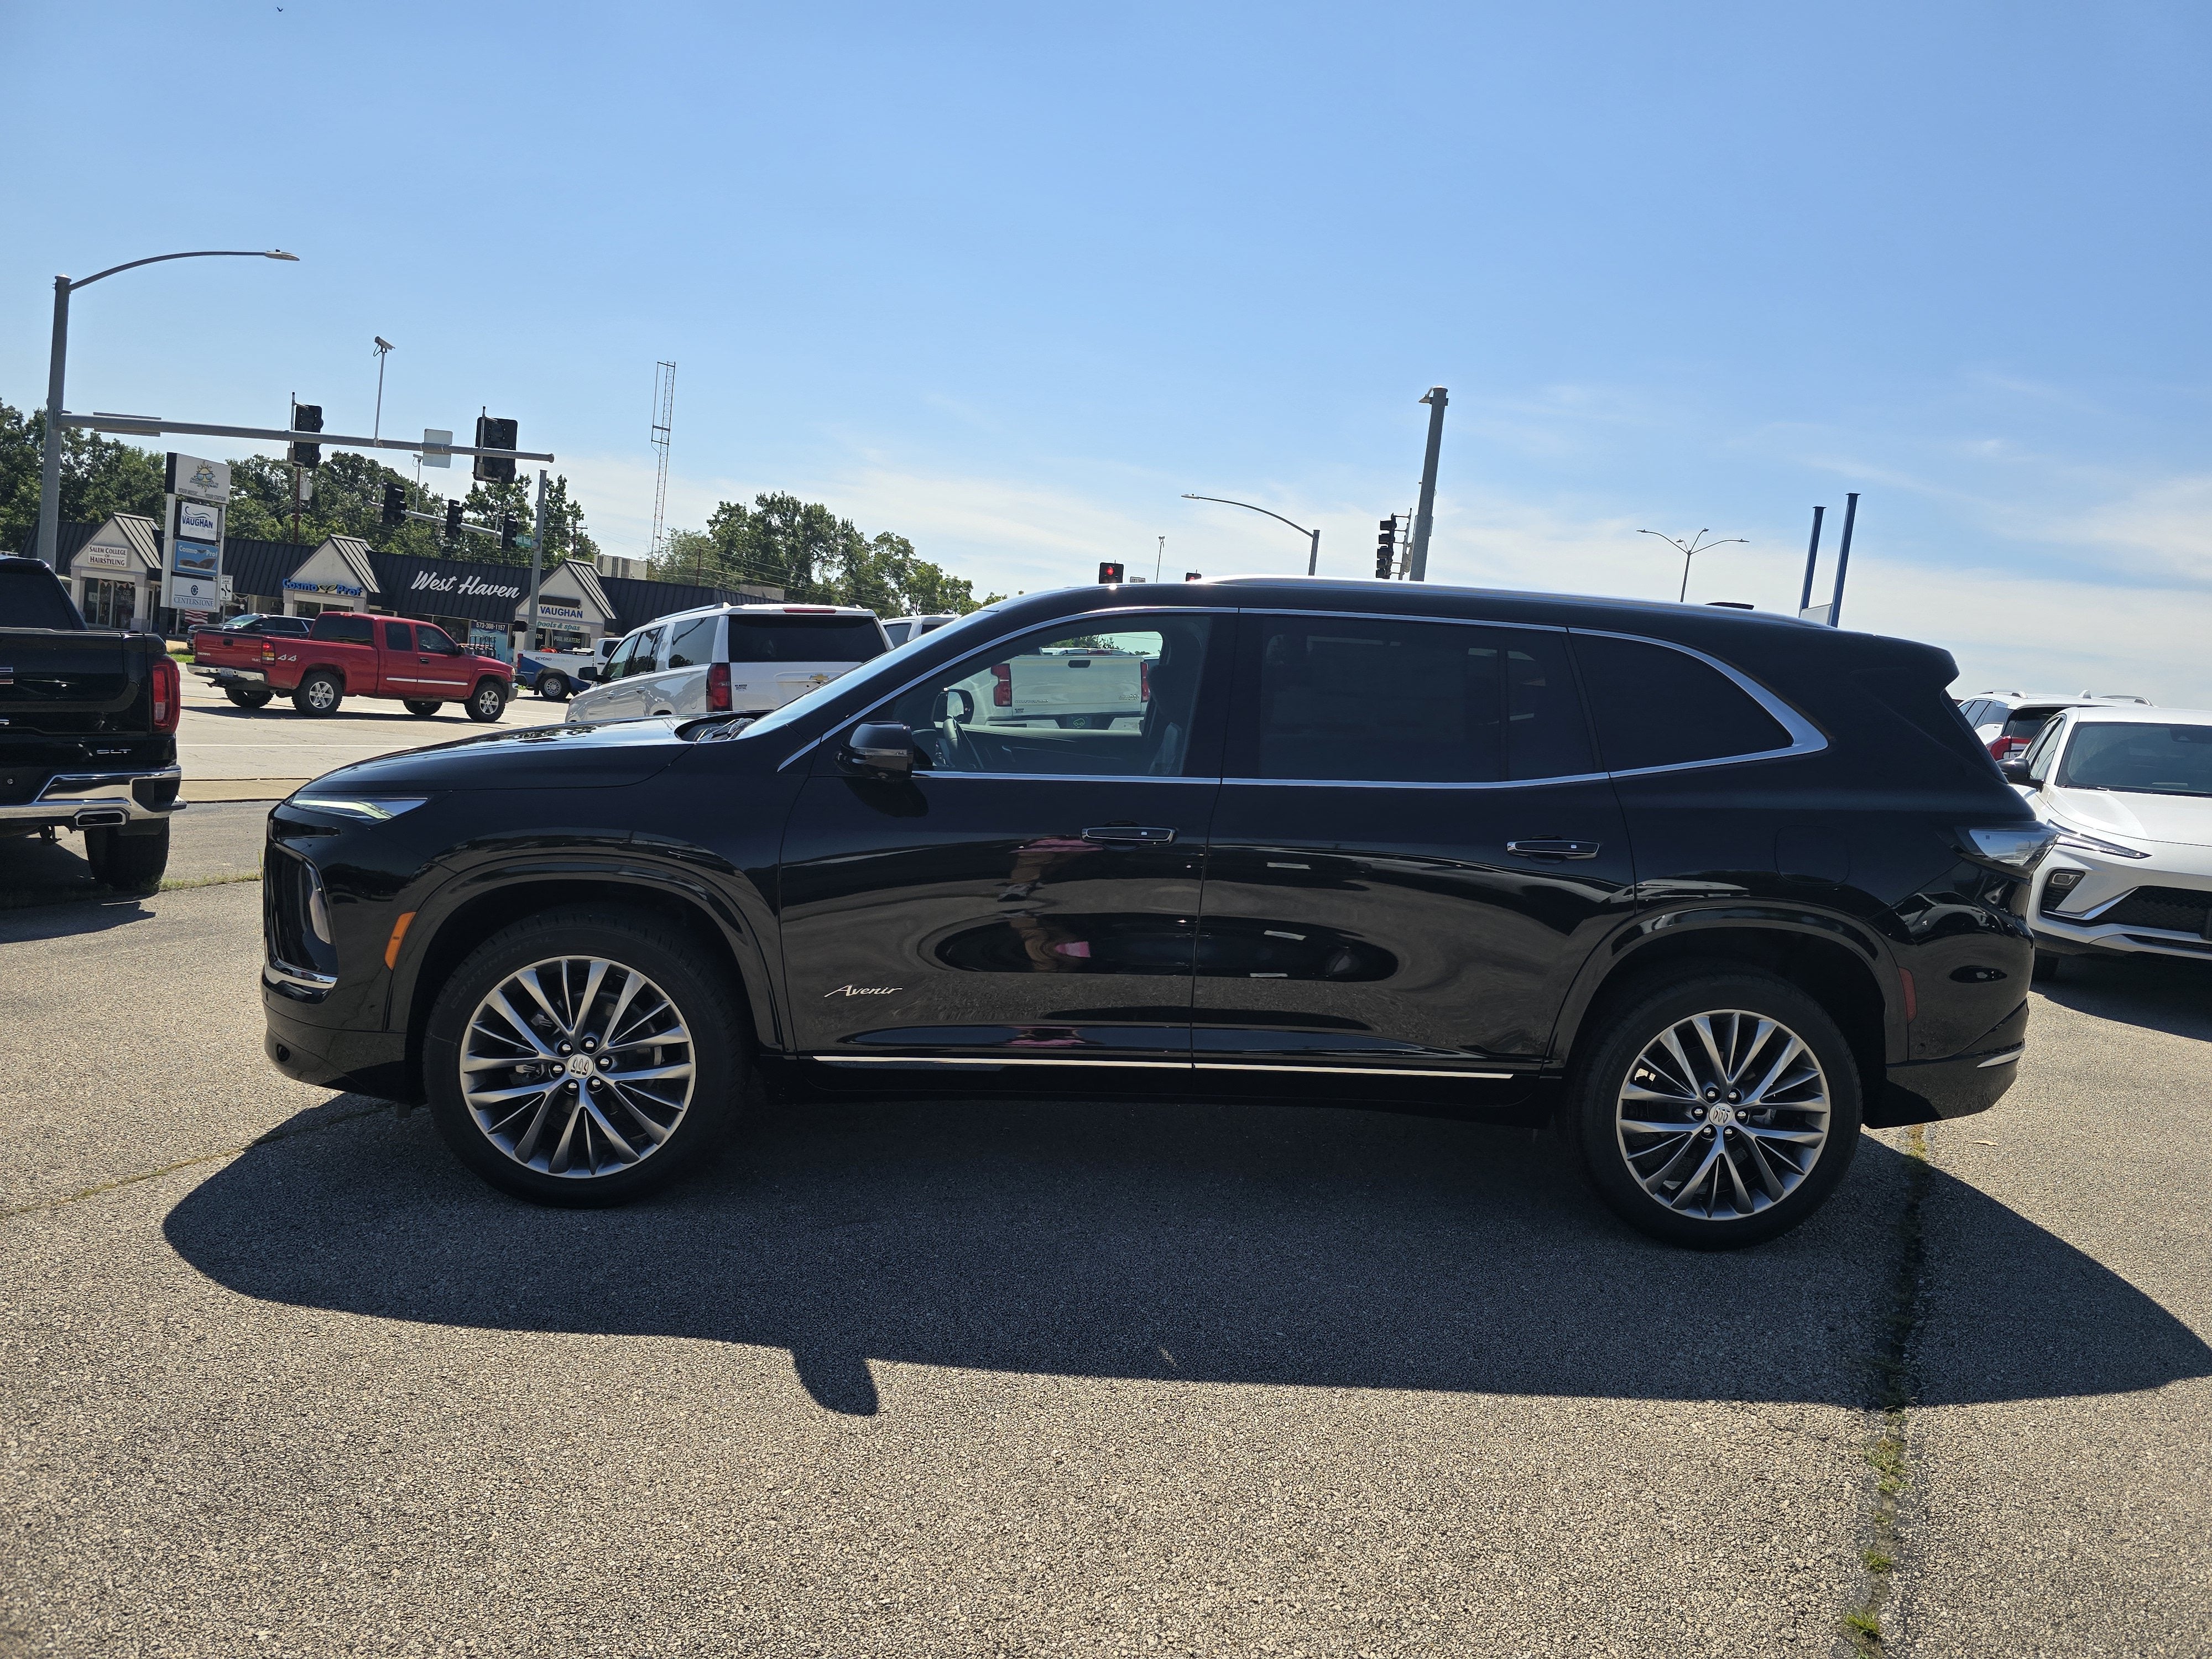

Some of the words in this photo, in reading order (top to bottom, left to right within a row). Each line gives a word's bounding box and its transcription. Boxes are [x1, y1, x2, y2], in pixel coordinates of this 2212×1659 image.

[182, 515, 213, 529] VAUGHAN
[179, 545, 197, 554] Cosmo
[90, 556, 125, 566] HAIRSTYLING
[283, 578, 319, 592] Cosmo
[336, 584, 363, 597] Prof
[411, 570, 457, 592] West
[457, 575, 520, 599] Haven
[174, 597, 213, 607] CENTERSTONE
[540, 606, 583, 619] VAUGHAN
[824, 984, 902, 998] Avenir
